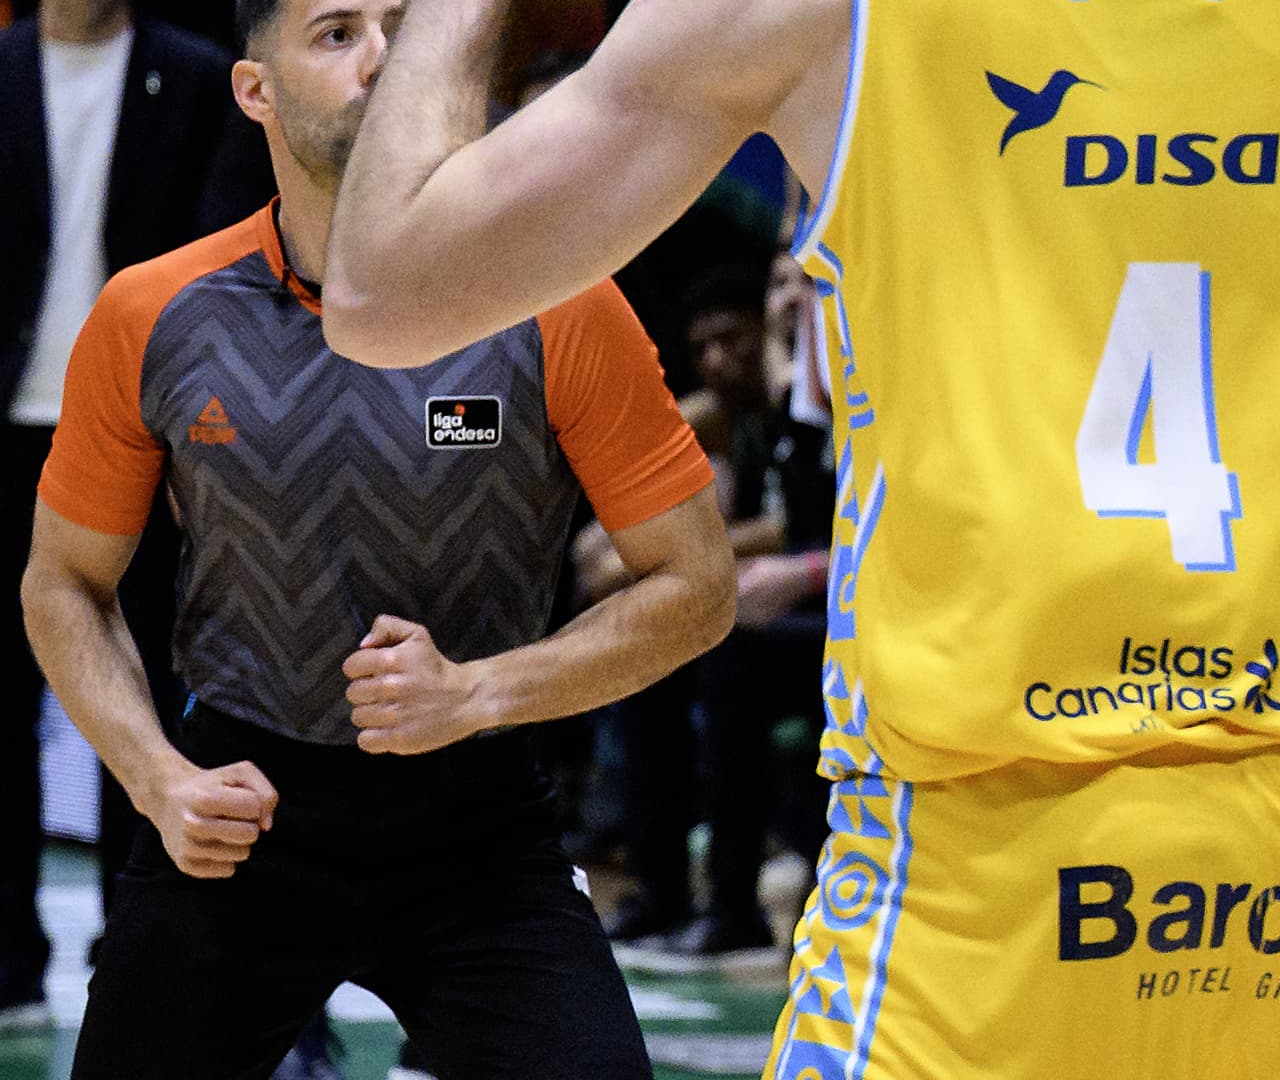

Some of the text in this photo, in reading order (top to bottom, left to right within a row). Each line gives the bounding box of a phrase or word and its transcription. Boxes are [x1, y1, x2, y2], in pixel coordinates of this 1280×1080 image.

[1063, 133, 1280, 187] DISA
[1076, 262, 1242, 571] 4
[1119, 637, 1233, 679] Islas
[1024, 679, 1236, 721] Canarias
[1137, 968, 1232, 1000] HOTEL
